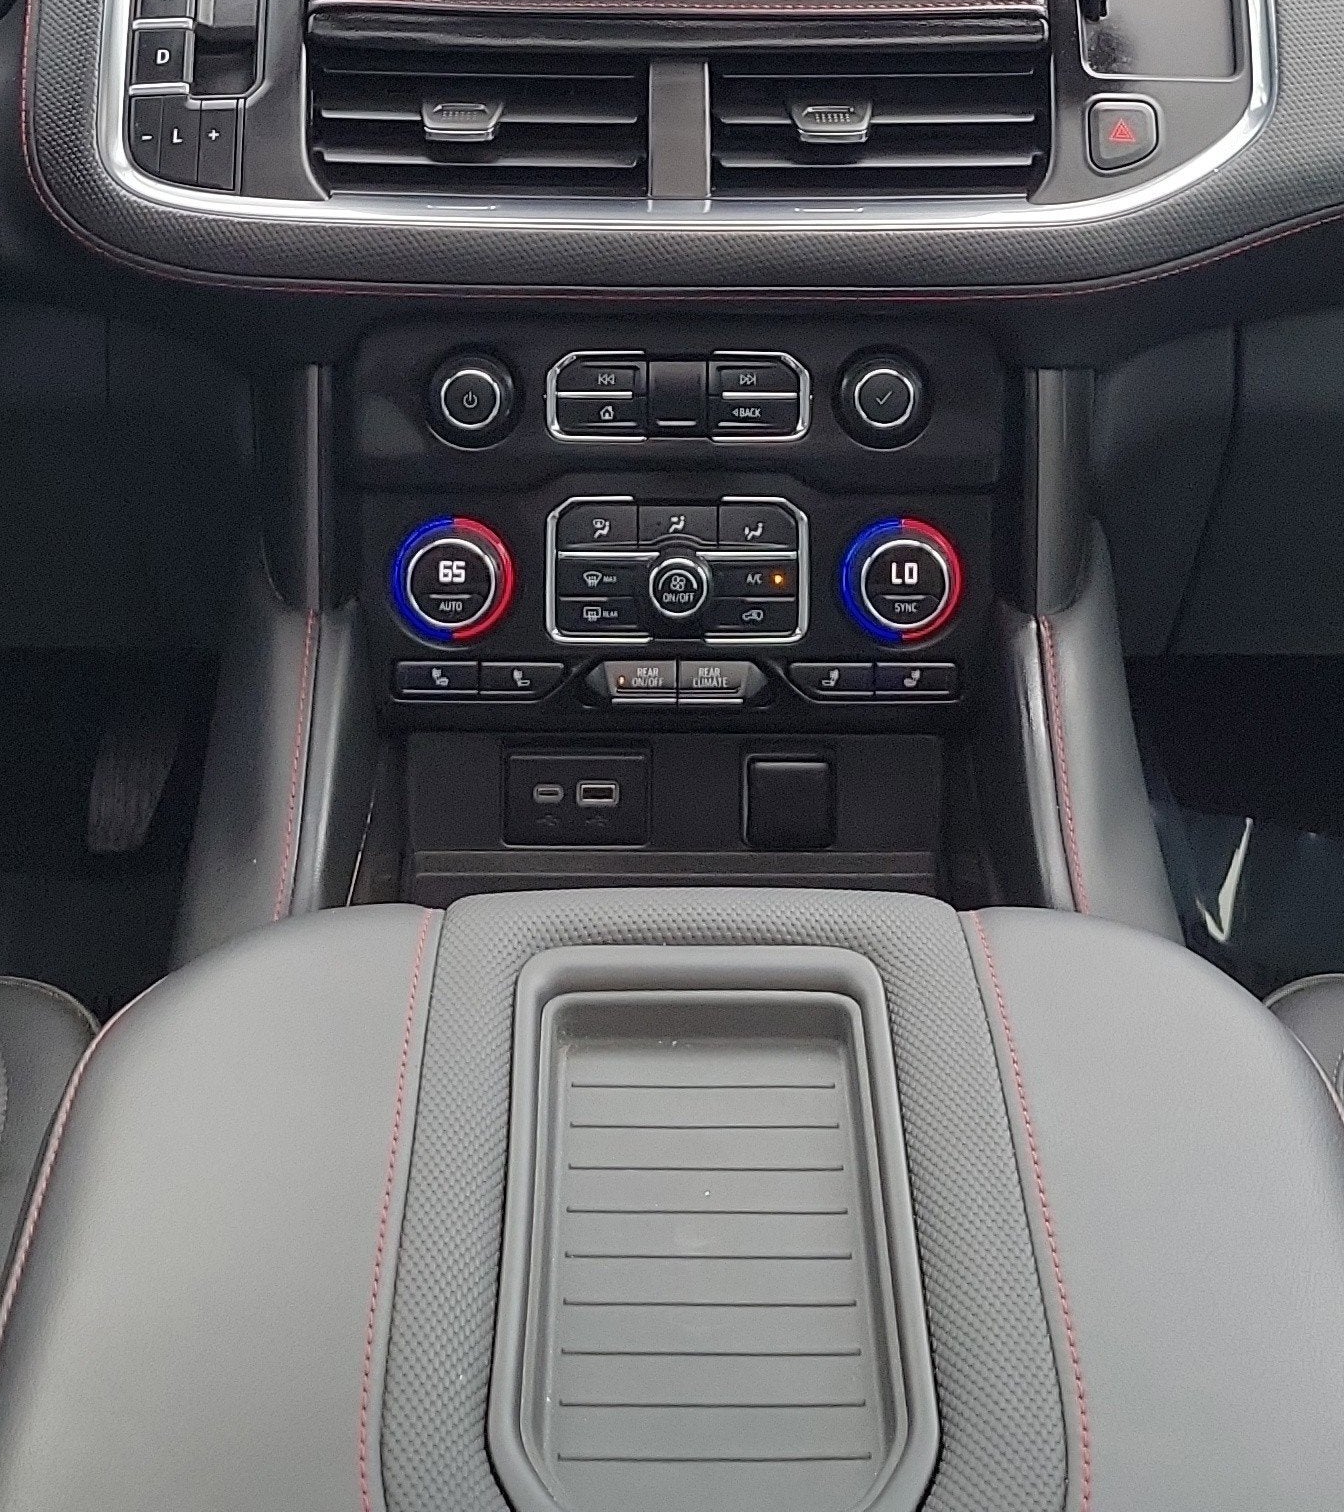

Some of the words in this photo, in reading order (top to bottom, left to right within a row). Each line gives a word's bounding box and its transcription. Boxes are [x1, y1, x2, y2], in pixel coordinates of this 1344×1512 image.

[156, 49, 171, 65] D
[172, 128, 183, 144] L
[739, 407, 762, 418] BACK
[439, 560, 466, 583] 65
[890, 562, 918, 585] LO
[746, 573, 764, 585] A/C
[662, 592, 695, 603] ON/OFF
[439, 601, 463, 611] AUTO
[894, 603, 918, 613] SYNC
[636, 667, 659, 677] REAR
[698, 667, 721, 677] REAR
[631, 677, 664, 688] ON/OFF
[692, 677, 729, 688] CLIMATE
